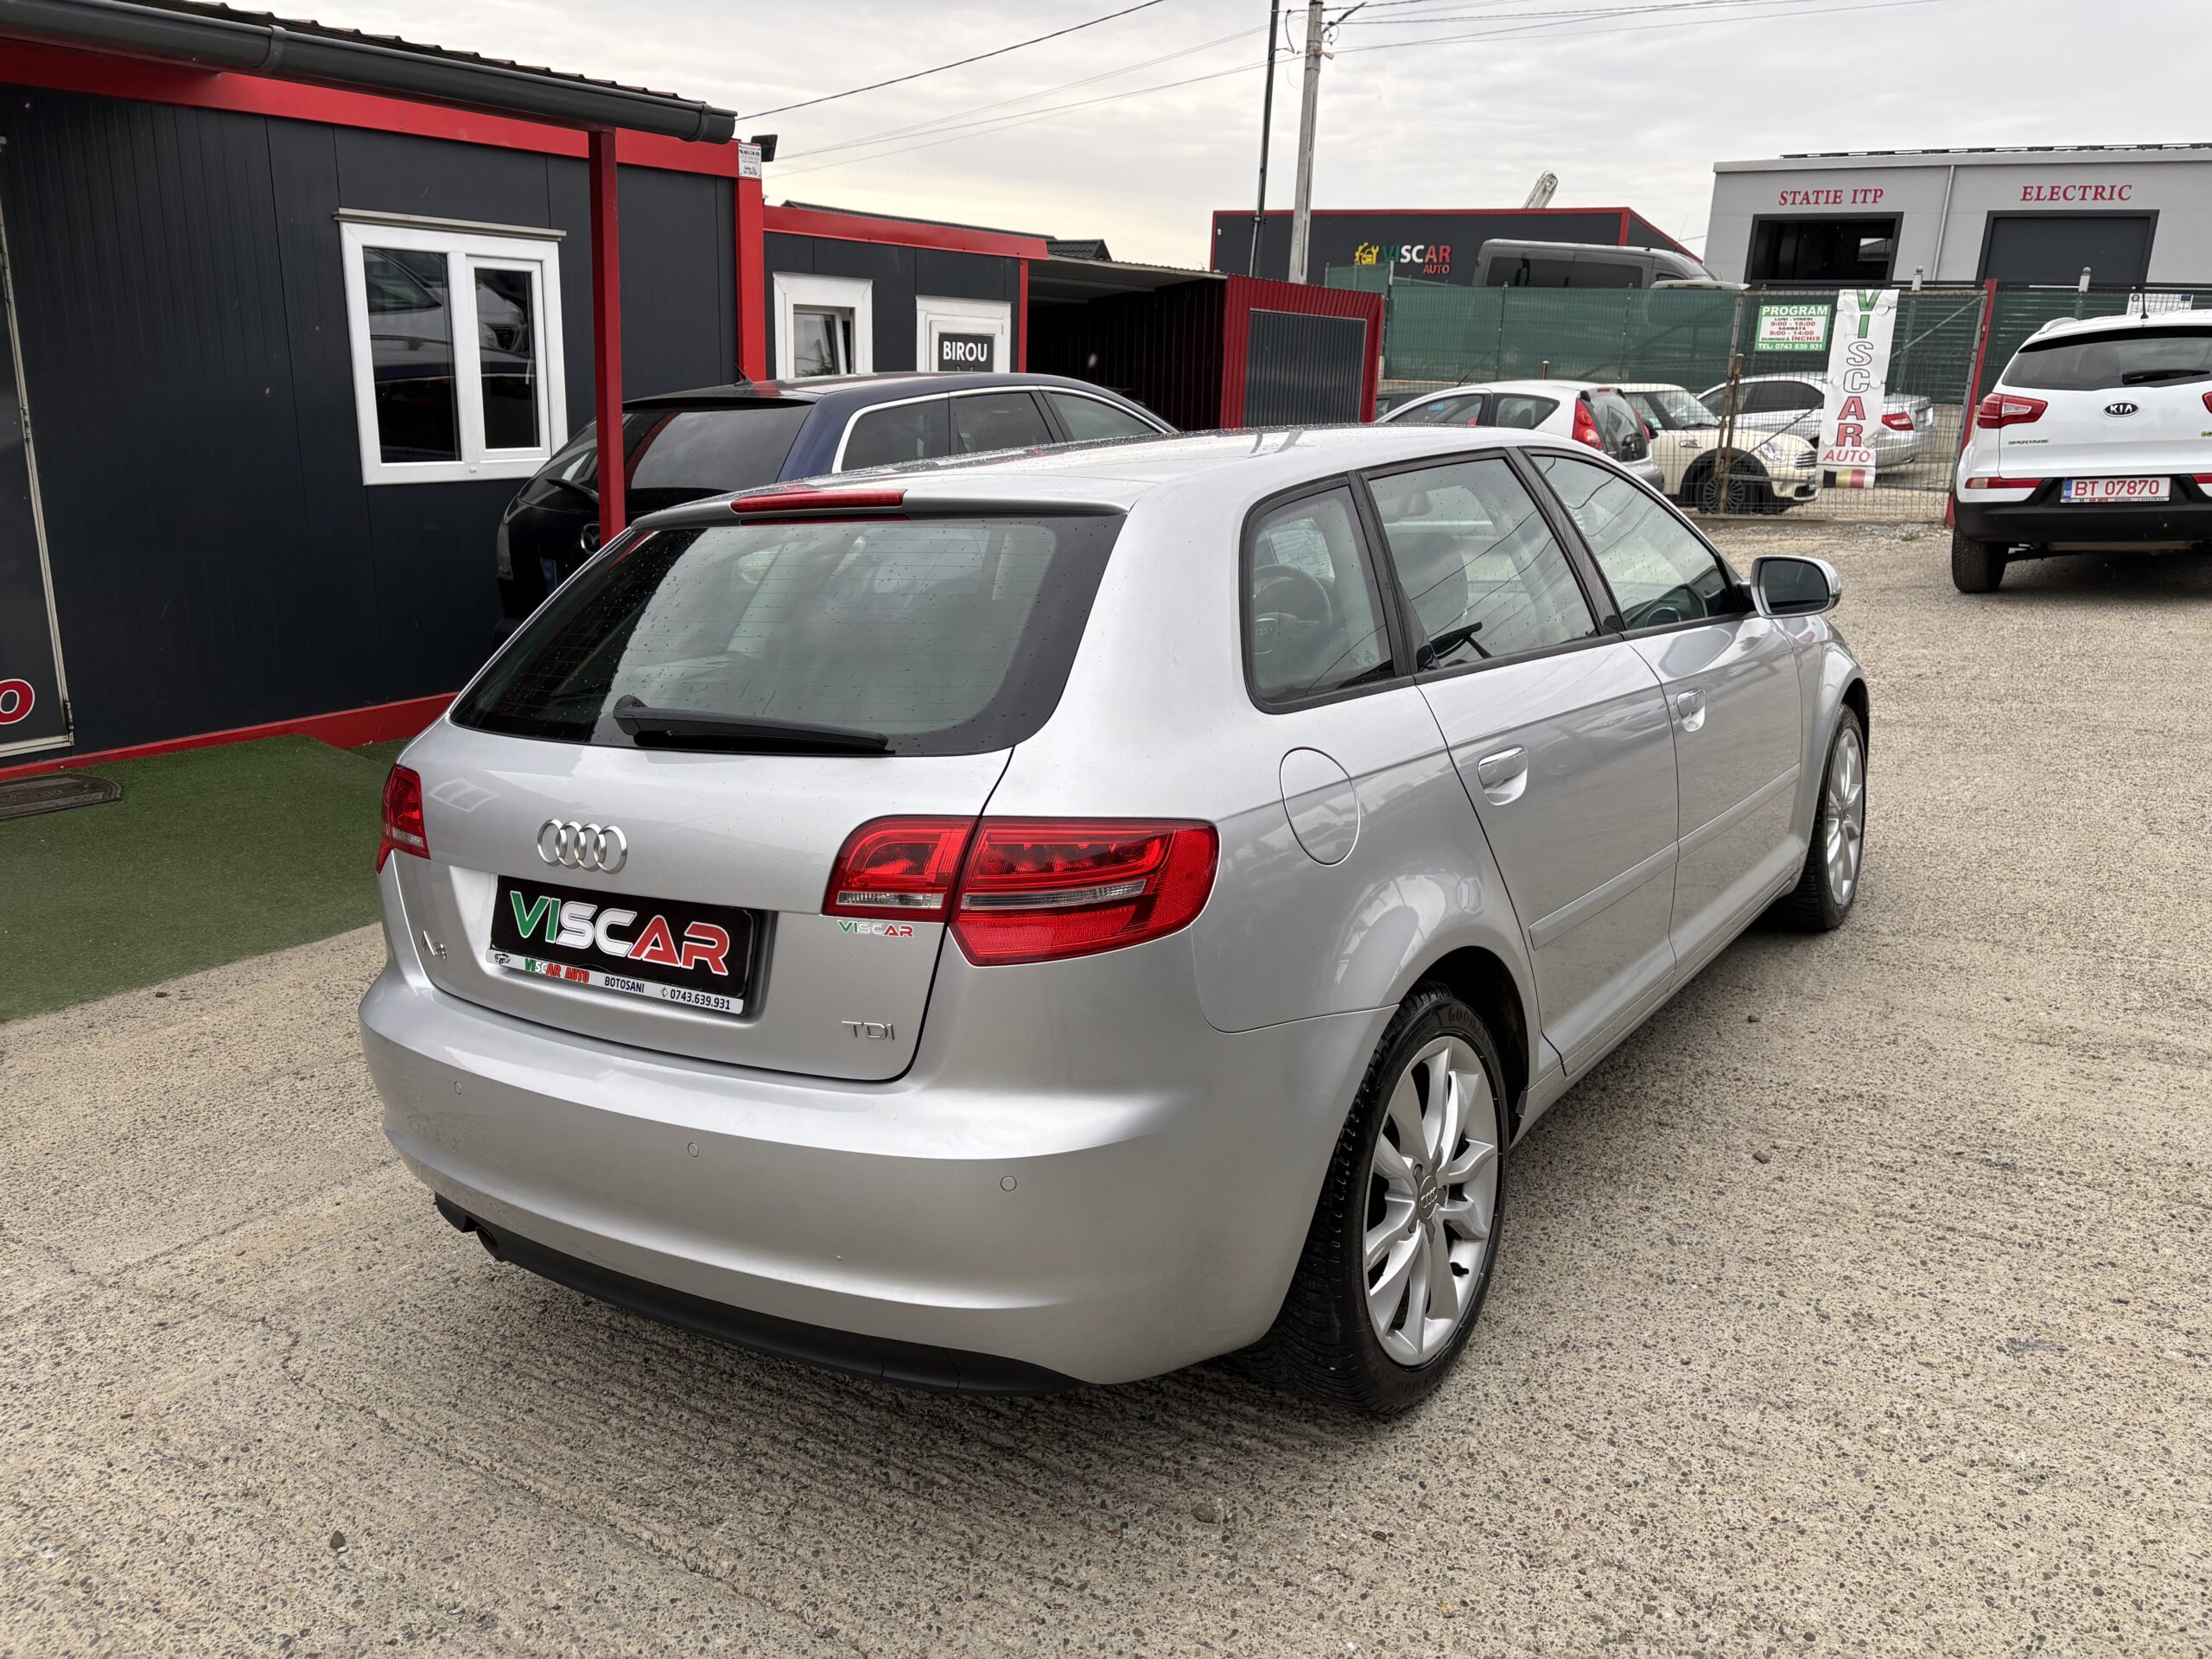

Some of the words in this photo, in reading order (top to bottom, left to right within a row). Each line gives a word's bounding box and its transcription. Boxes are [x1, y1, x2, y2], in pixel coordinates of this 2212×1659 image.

[1778, 189, 1843, 206] STATIE
[1850, 188, 1884, 204] ITP
[2019, 184, 2133, 201] ELECTRIC
[1382, 245, 1452, 263] VISCAR
[1423, 264, 1450, 275] AUTO
[1762, 306, 1828, 315] PROGRAM
[943, 340, 988, 362] BIROU
[2109, 404, 2133, 414] KIA
[1823, 449, 1872, 463] AUTO
[2075, 480, 2099, 496] BT
[2104, 480, 2160, 496] 07870
[510, 890, 729, 976] VISCAR
[837, 920, 915, 938] VISCAR
[524, 957, 562, 978] VISCAR
[564, 967, 590, 983] AUTO
[604, 976, 645, 995] BOTOSANI
[670, 988, 731, 1011] 0743.639.931
[841, 1020, 895, 1041] TDI
